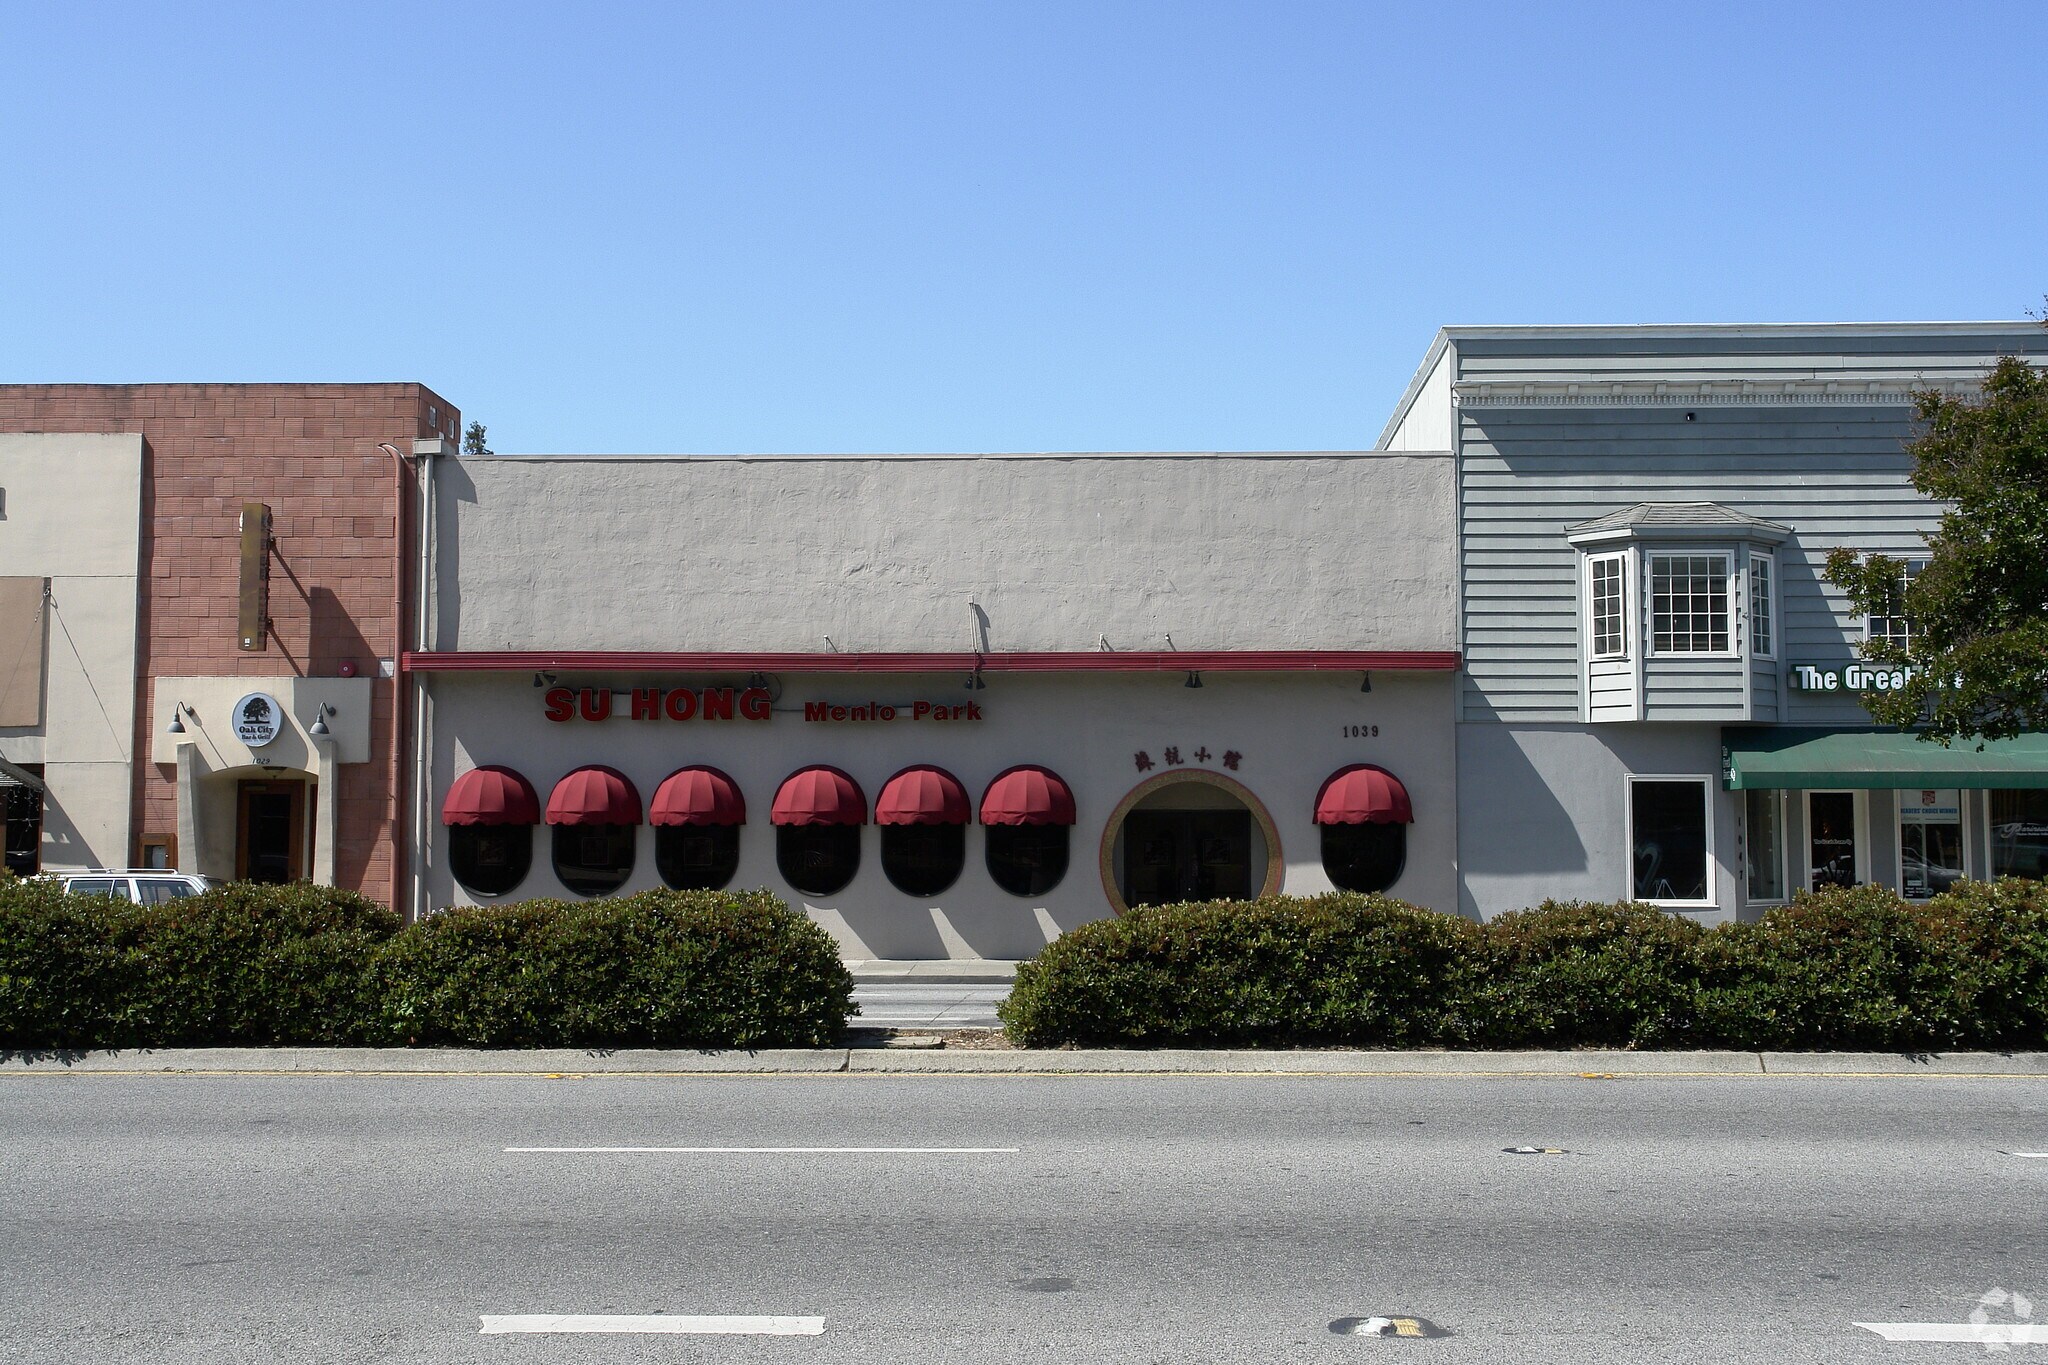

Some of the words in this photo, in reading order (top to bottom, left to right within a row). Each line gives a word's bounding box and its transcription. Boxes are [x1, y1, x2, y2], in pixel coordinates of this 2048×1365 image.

[1795, 665, 1838, 690] The
[1845, 665, 1916, 690] Great
[544, 687, 612, 722] SU
[631, 687, 771, 722] HONG
[804, 700, 897, 722] Menlo
[912, 700, 983, 722] Park
[257, 726, 274, 734] City
[1343, 725, 1379, 738] 1039
